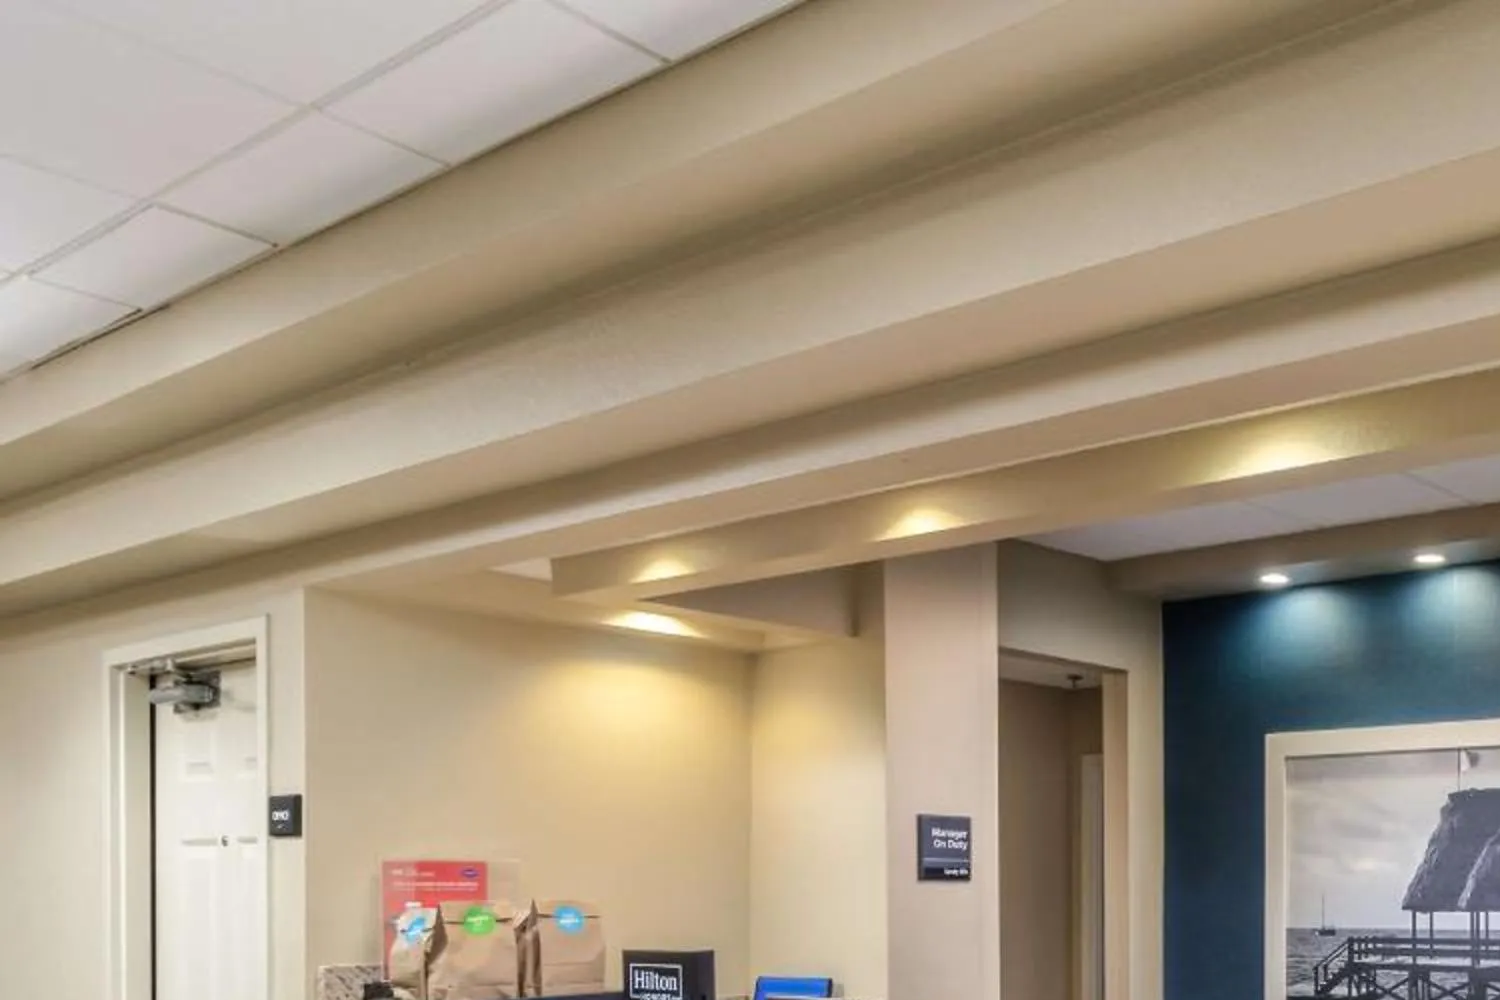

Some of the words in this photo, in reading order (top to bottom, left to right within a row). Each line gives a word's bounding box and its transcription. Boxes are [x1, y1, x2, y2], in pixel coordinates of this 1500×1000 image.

[931, 828, 968, 840] Manager
[934, 839, 947, 848] On
[948, 840, 968, 850] Duty
[634, 969, 678, 990] Hilton
